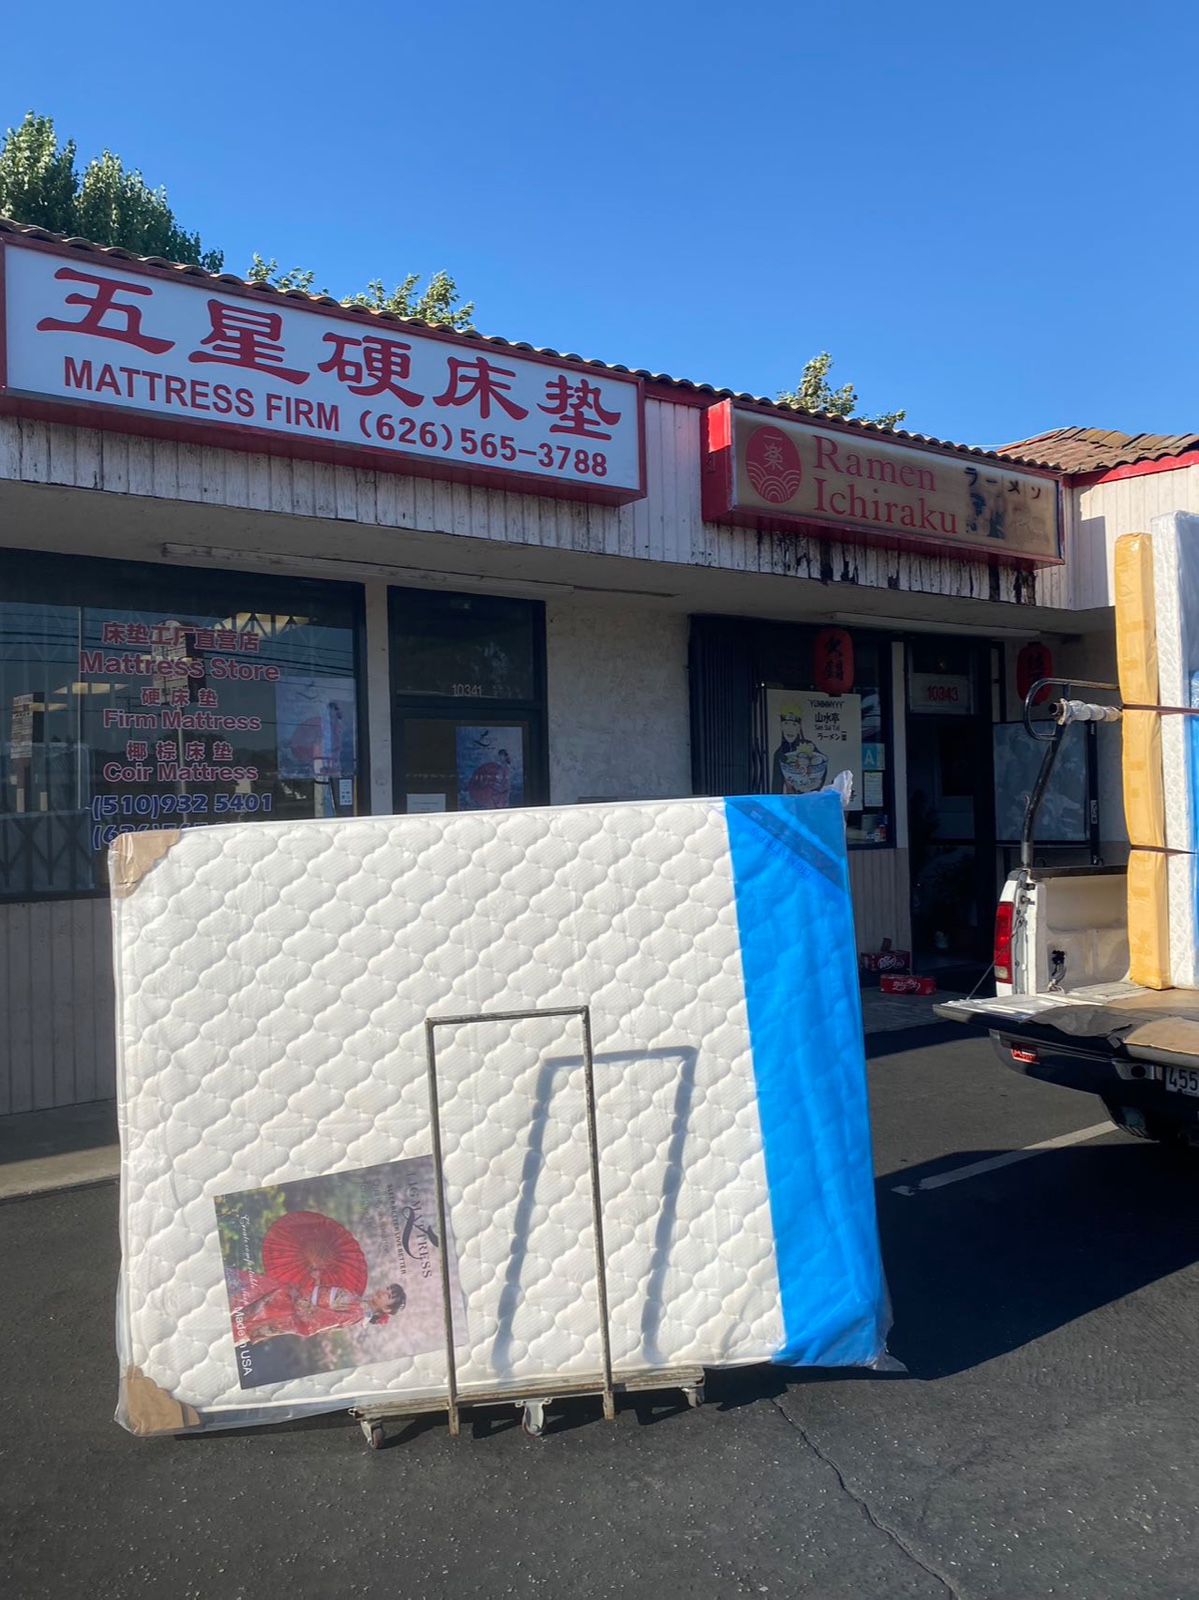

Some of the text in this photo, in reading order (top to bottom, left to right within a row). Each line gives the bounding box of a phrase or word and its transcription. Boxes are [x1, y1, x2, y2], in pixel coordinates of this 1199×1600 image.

[36, 267, 622, 442] 五星硬床垫
[63, 356, 608, 478] MATTRESS FIRM (626)565-3788
[812, 434, 937, 492] Ramen
[813, 477, 958, 535] Ichiraku
[102, 622, 260, 652] 床垫工厂直营店
[80, 650, 281, 681] Mattress Store
[141, 687, 219, 708] 硬床垫
[452, 683, 482, 697] 10341
[103, 710, 262, 731] Firm Mattress
[127, 741, 233, 761] 椰棕床垫
[864, 749, 875, 765] A
[103, 763, 259, 782] Coir Mattress
[92, 793, 272, 820] (510)932 5401
[397, 1248, 407, 1275] BETTER
[234, 1306, 246, 1337] Made
[241, 1349, 253, 1376] USA
